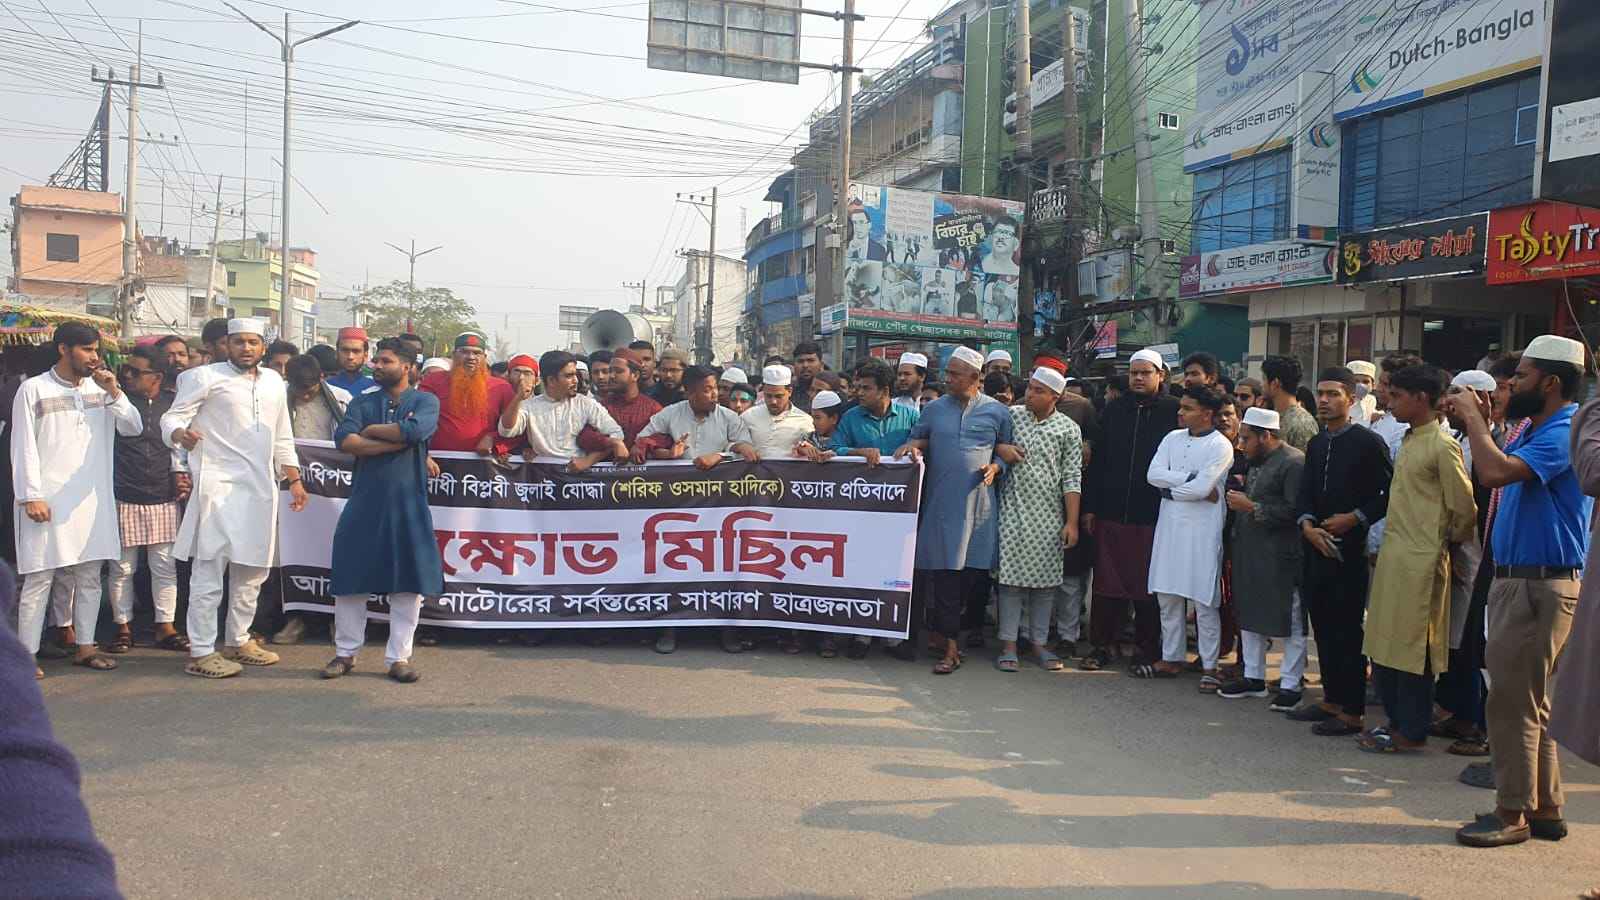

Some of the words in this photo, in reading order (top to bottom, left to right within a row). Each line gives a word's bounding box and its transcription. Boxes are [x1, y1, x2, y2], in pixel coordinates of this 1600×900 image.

[1388, 9, 1534, 70] Dutch-Bangla
[935, 221, 968, 240] বিচার
[957, 231, 977, 247] চাই
[461, 474, 510, 498] বিপ্লবী
[514, 479, 556, 503] জুলাই
[562, 481, 605, 500] যোদ্ধা
[611, 476, 663, 502] (শরিফ
[669, 480, 725, 497] ওসমান
[728, 474, 784, 501] হাদিকে)
[789, 481, 836, 498] হত্যার
[839, 477, 908, 501] প্রতিবাদে
[433, 529, 619, 578] ক্ষোভ
[642, 511, 849, 581] মিছিল
[438, 586, 554, 614] নাটোরের
[561, 586, 671, 613] সর্বস্তরের
[678, 589, 764, 611] সাধারণ
[770, 592, 885, 621] ছাত্রজনতা
